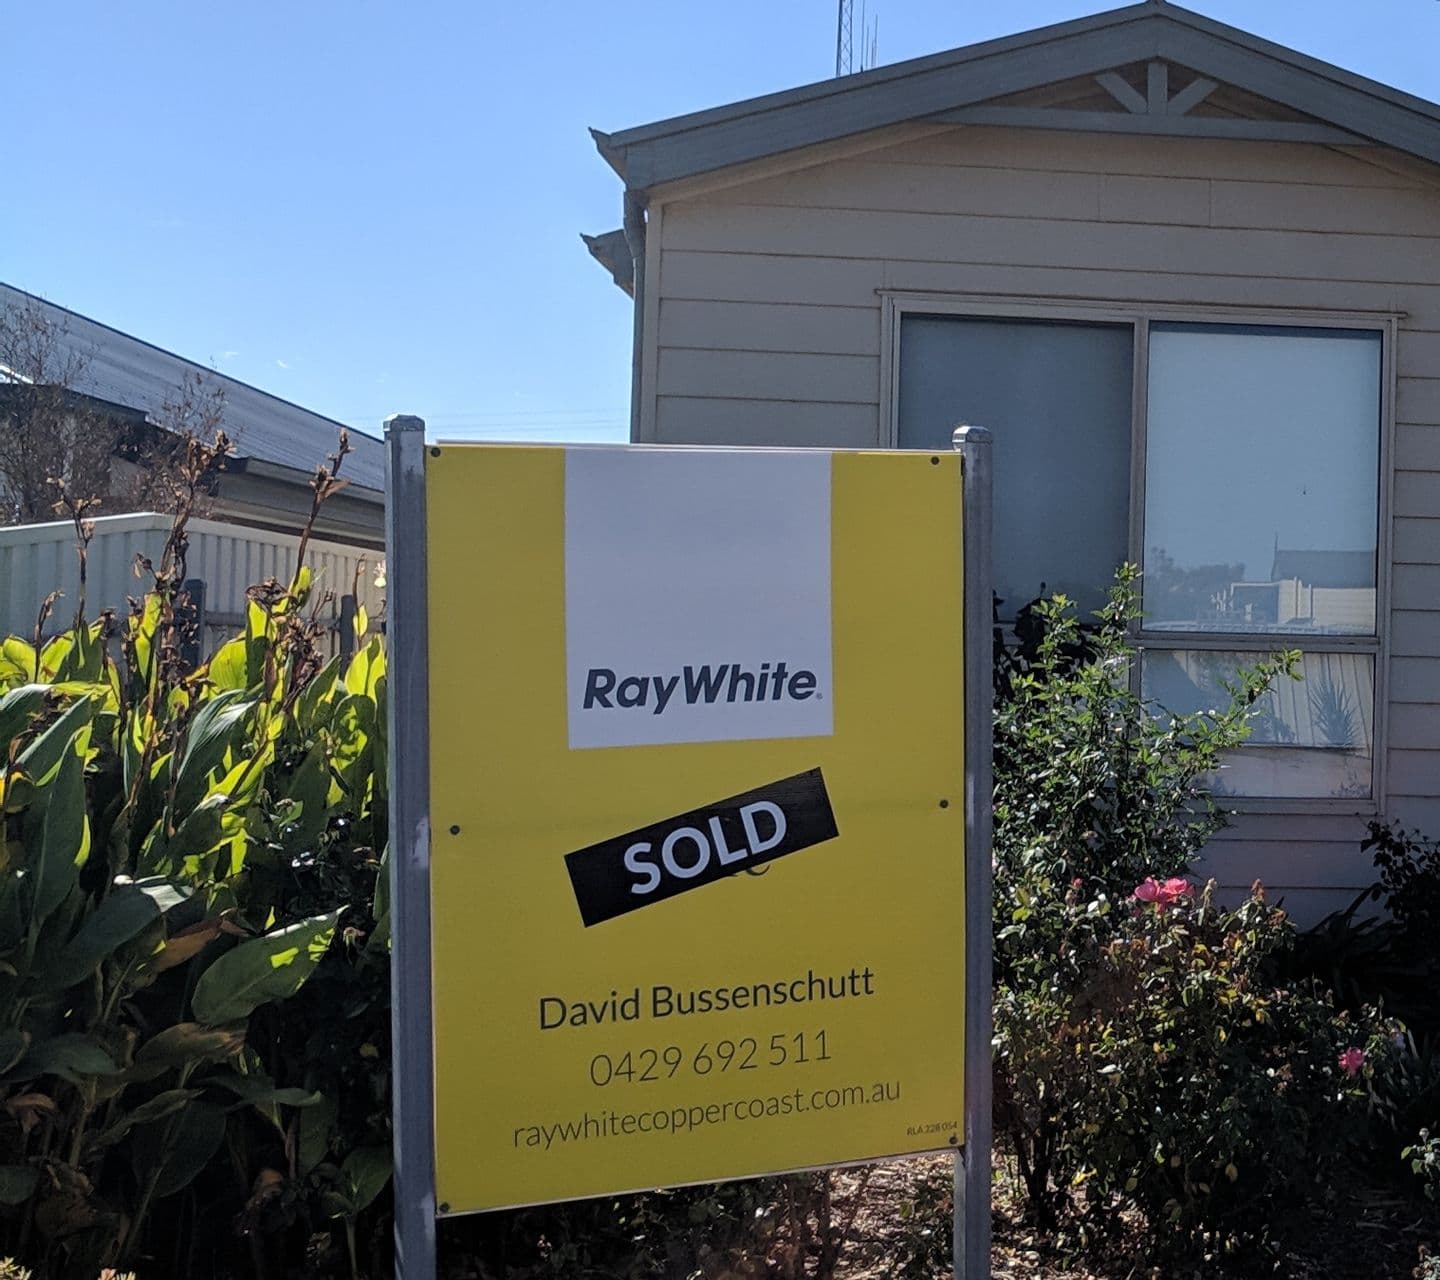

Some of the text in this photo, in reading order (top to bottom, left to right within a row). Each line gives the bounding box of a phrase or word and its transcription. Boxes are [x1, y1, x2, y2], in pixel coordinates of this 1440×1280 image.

[624, 800, 787, 895] SOLD
[540, 967, 875, 1030] David Bussenschutt
[590, 1029, 832, 1087] 0429 692 511
[513, 1080, 901, 1151] raywhitecoppercoast.com.au
[906, 1126, 924, 1137] RLA
